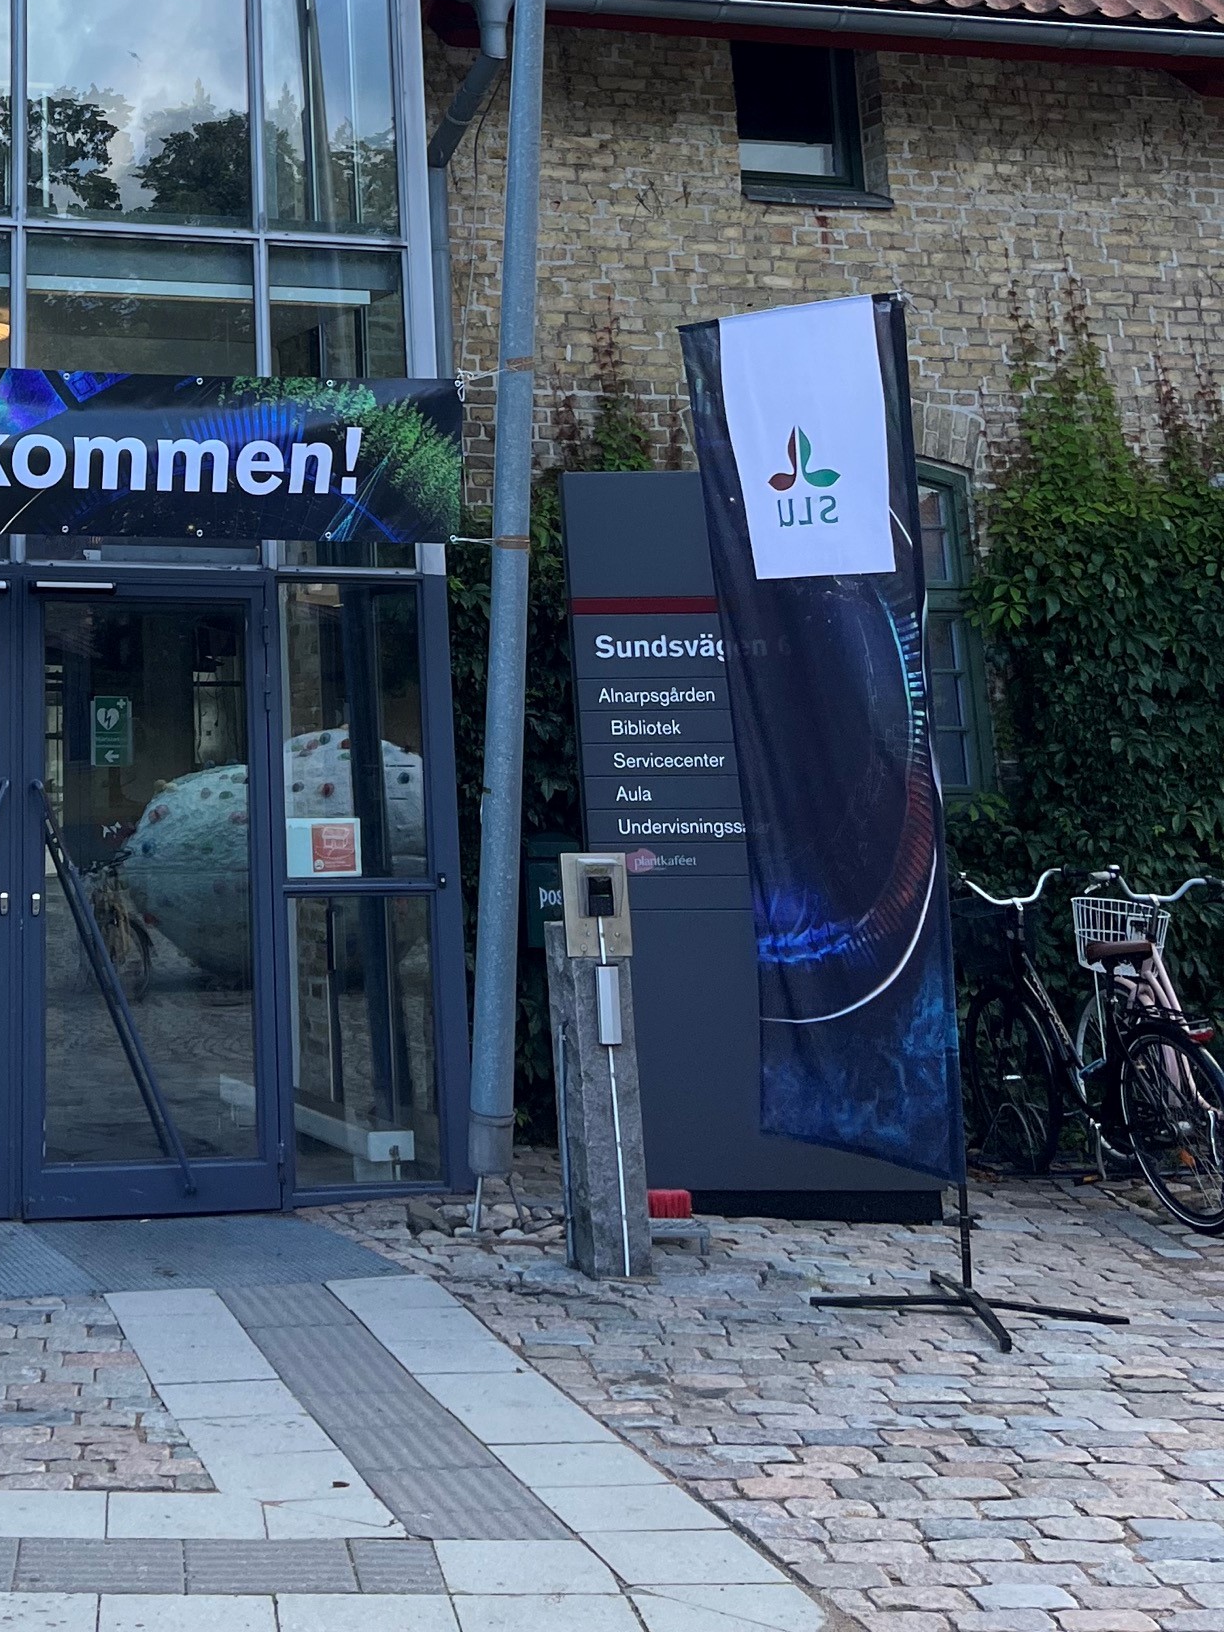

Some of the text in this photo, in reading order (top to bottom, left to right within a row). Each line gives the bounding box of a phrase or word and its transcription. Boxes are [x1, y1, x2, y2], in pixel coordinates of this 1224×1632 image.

[598, 686, 716, 707] Alnarpsgården
[611, 719, 682, 736] Bibliotek
[613, 752, 725, 769] Servicecenter
[616, 785, 653, 802] Aula
